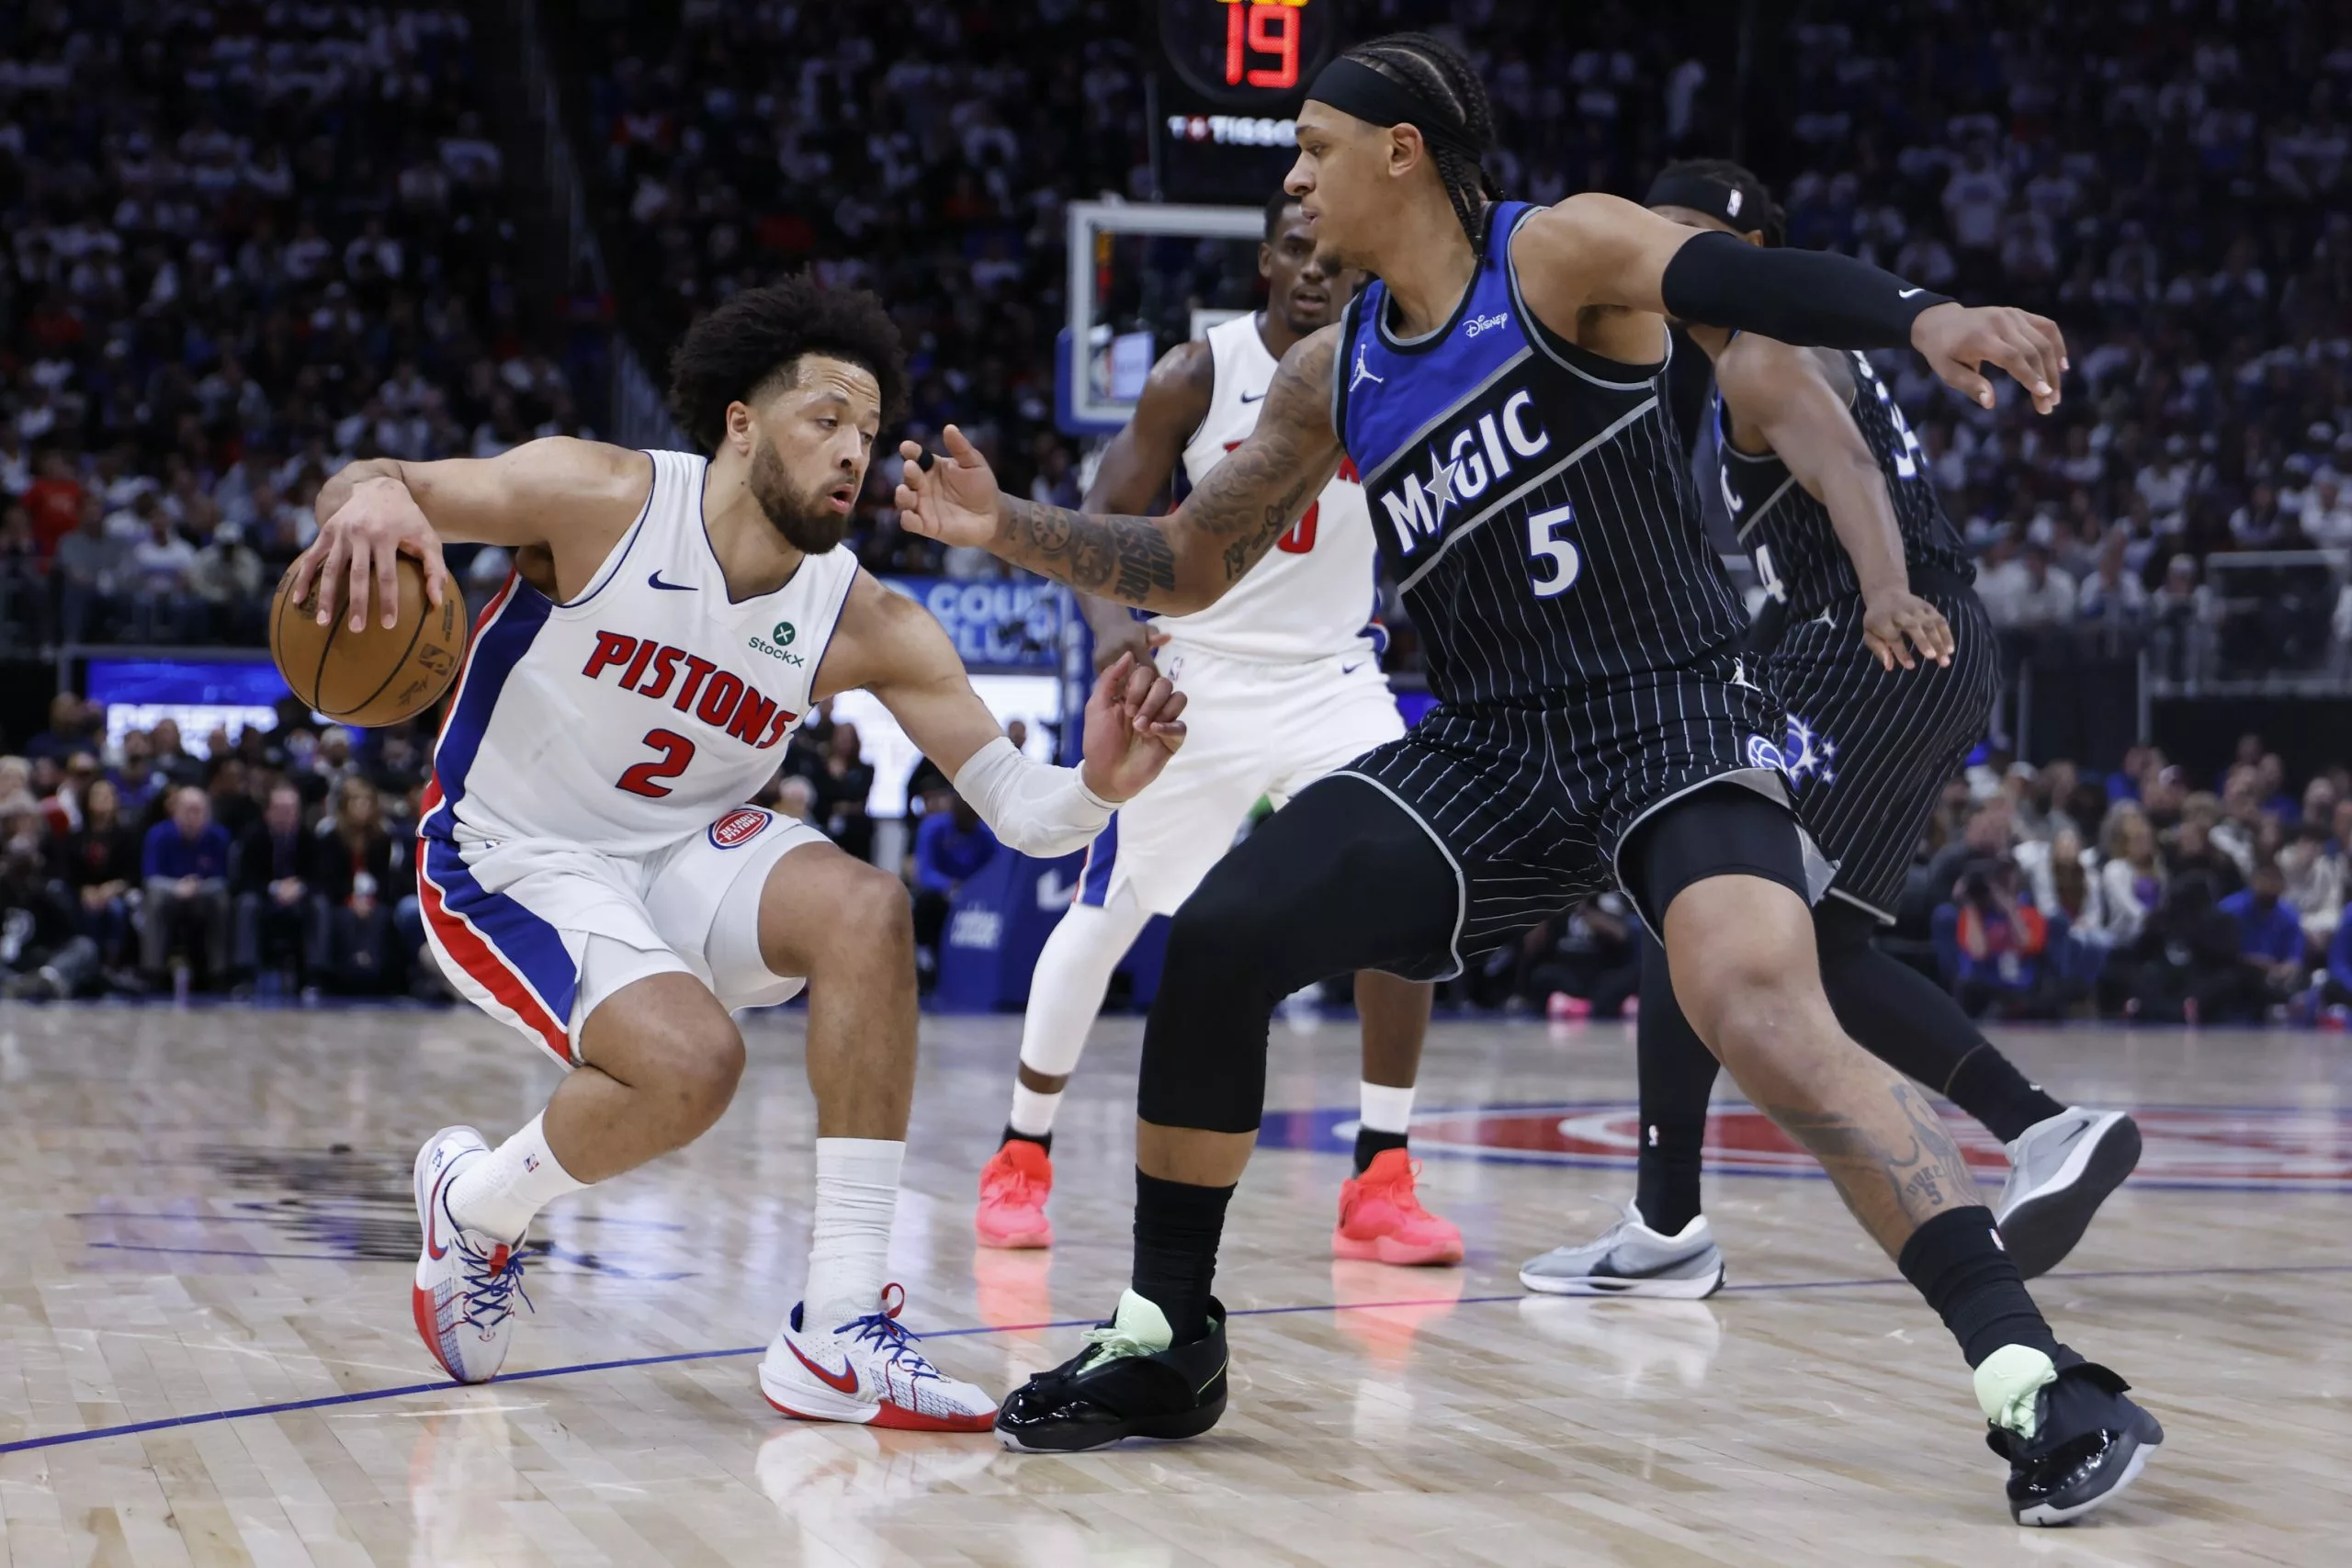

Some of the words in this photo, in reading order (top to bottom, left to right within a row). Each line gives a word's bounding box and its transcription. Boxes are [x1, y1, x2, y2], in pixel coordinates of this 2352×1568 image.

[1226, 3, 1300, 88] 19
[1208, 116, 1298, 147] TISSO
[1527, 503, 1580, 598] 5
[582, 630, 797, 749] PISTONS
[615, 728, 695, 797] 2
[719, 813, 755, 836] DETROIT
[724, 816, 761, 840] PISTONS
